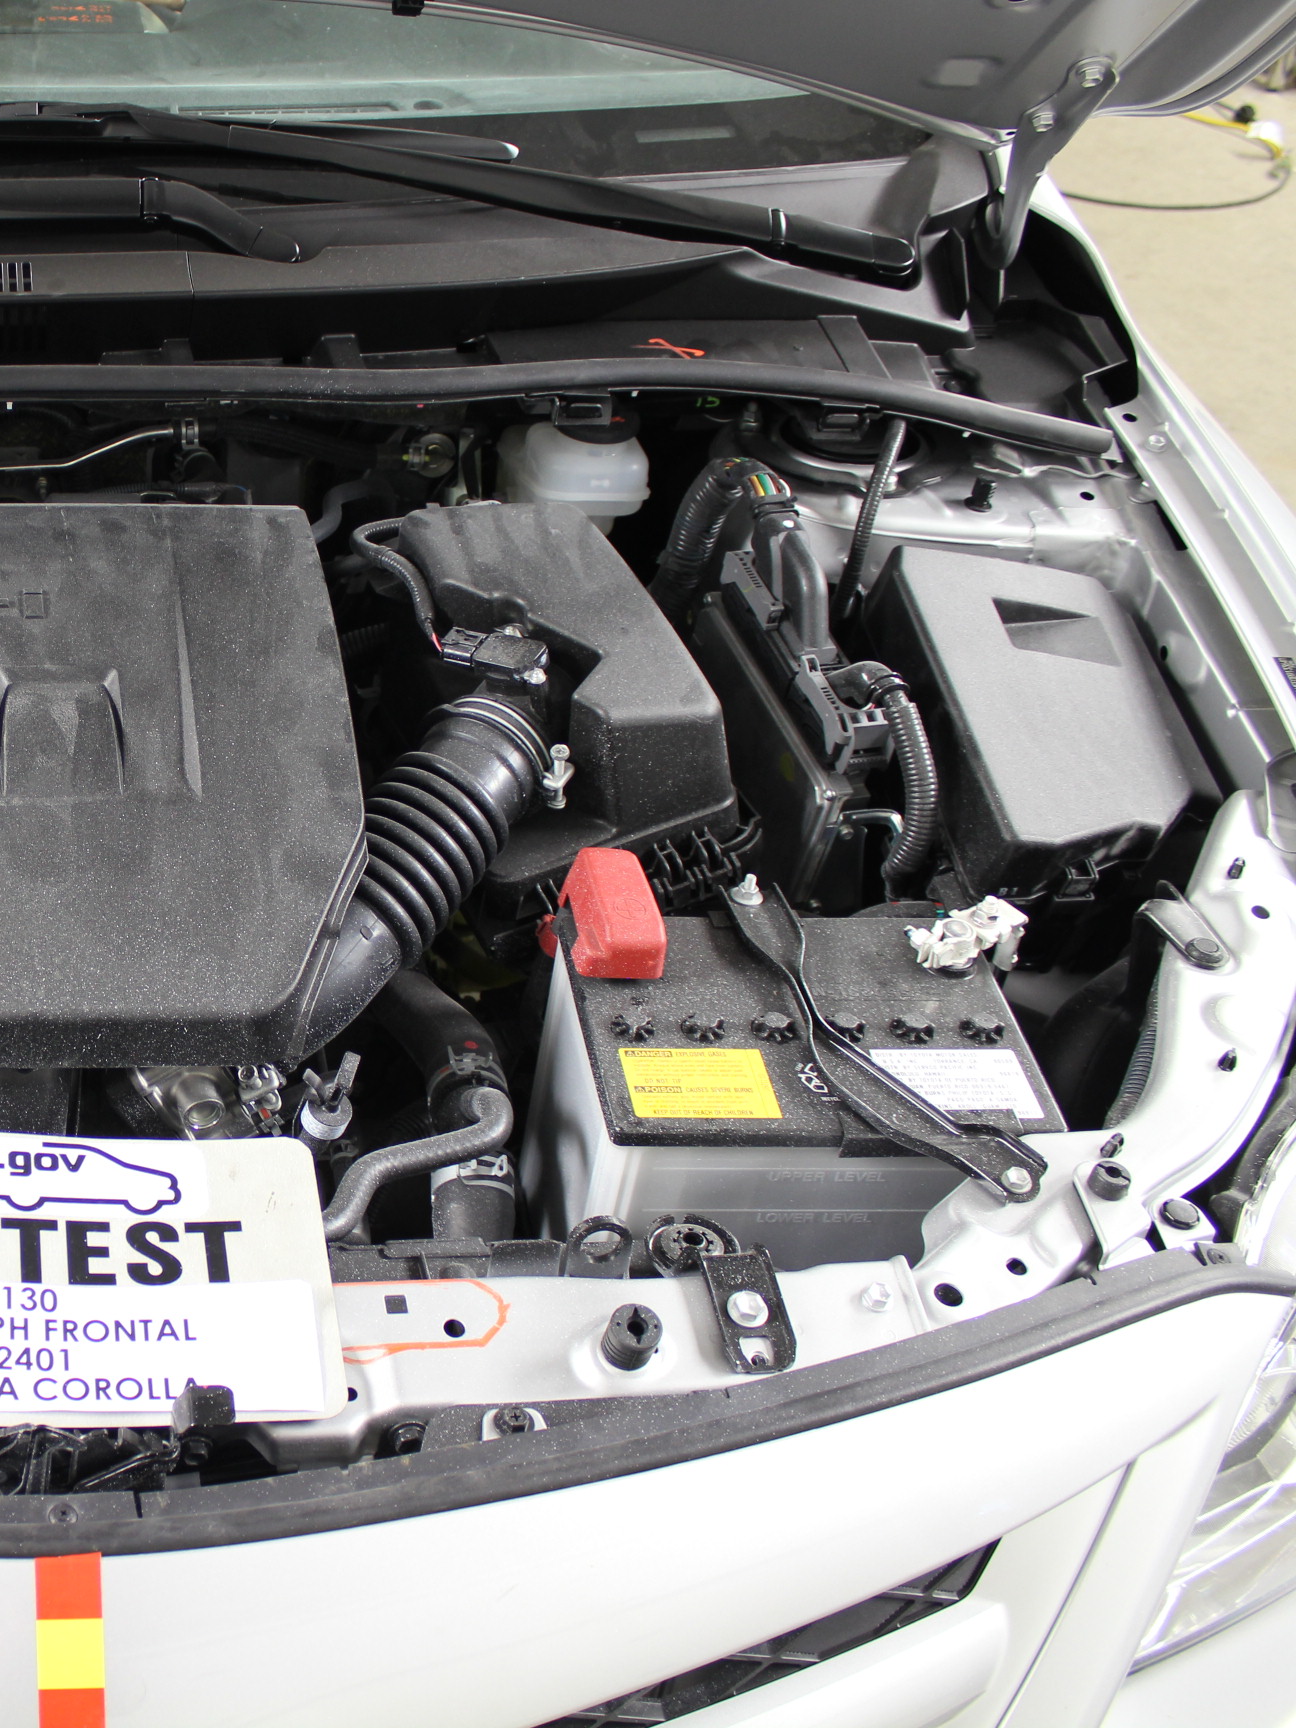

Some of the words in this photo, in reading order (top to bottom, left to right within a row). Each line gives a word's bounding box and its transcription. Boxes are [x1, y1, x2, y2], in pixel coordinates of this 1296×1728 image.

[767, 1171, 826, 1182] UPPER
[834, 1171, 886, 1182] LEVEL
[756, 1212, 814, 1223] LOWER
[822, 1212, 872, 1223] LEVEL
[45, 1318, 197, 1342] FRONTAL
